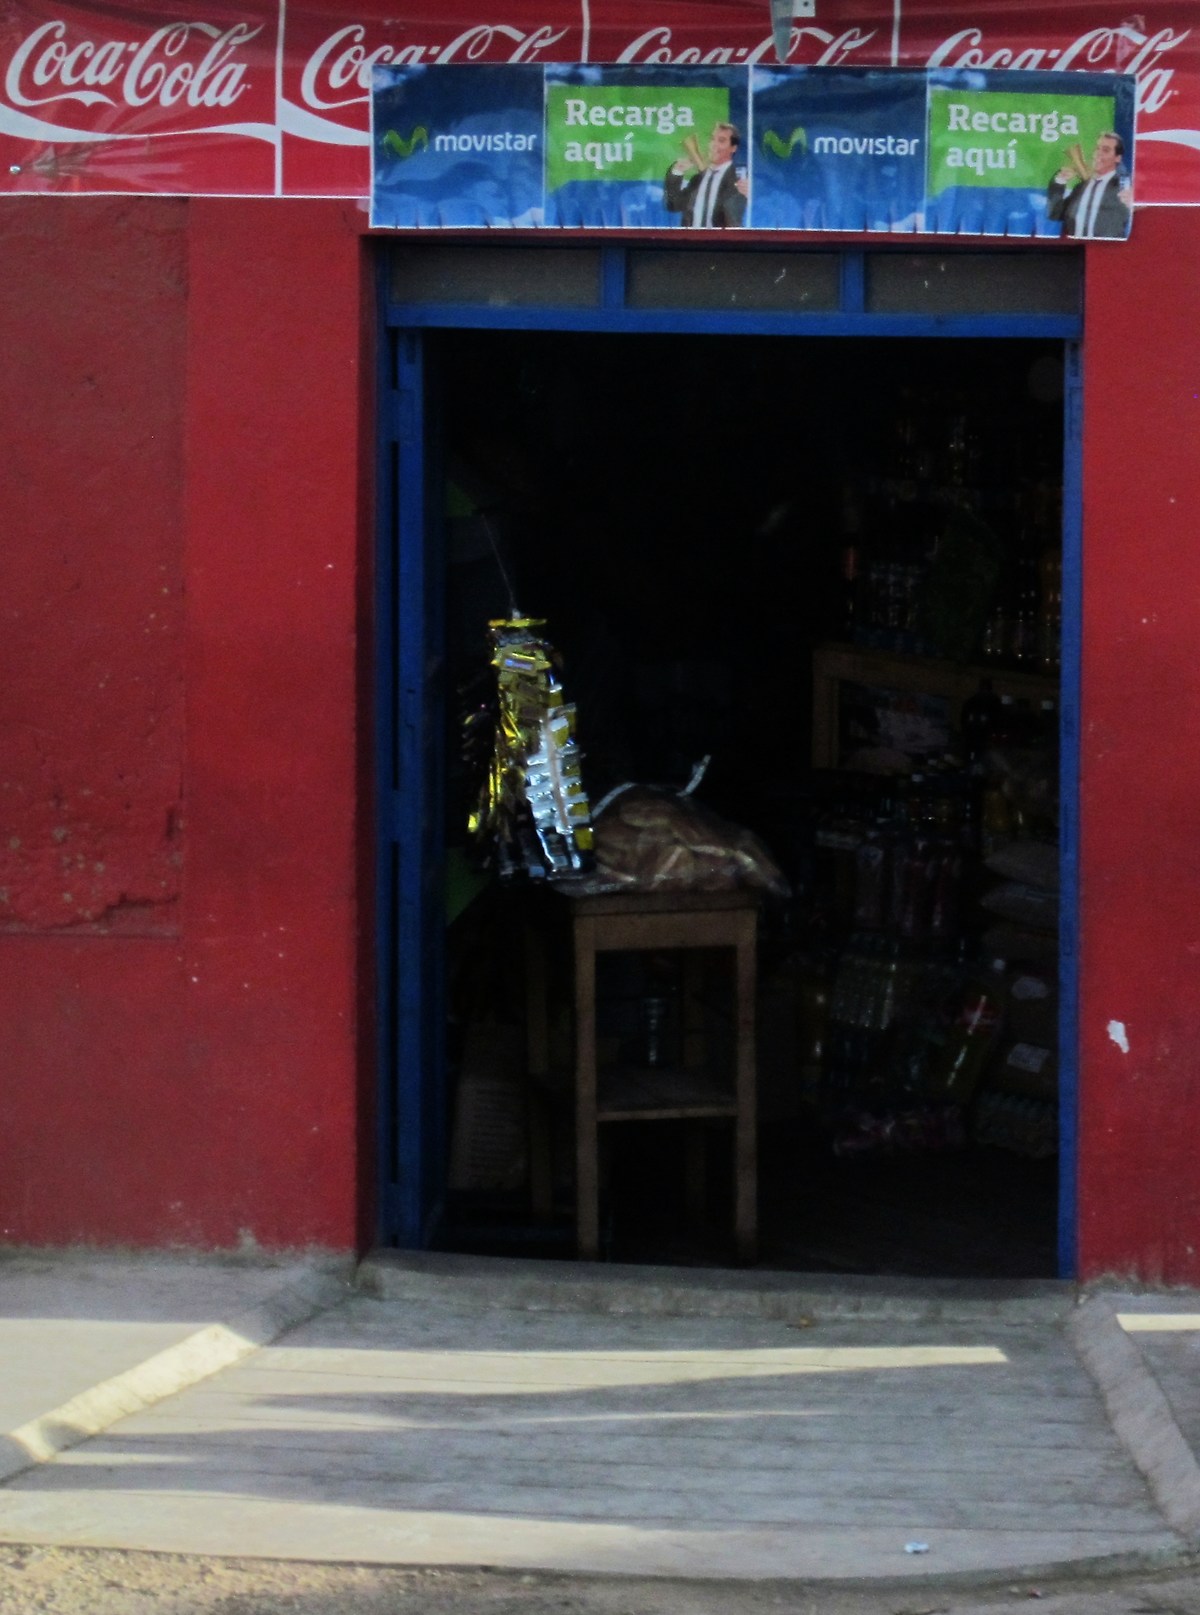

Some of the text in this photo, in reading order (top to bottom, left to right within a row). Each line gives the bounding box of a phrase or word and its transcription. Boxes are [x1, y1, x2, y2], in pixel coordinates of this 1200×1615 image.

[5, 20, 266, 108] Coca-Cola
[564, 99, 695, 135] Recarga
[947, 103, 1079, 143] Recarga
[434, 132, 537, 152] movistar
[563, 131, 634, 170] aquí
[813, 135, 920, 156] movistar
[945, 138, 1018, 176] aquí
